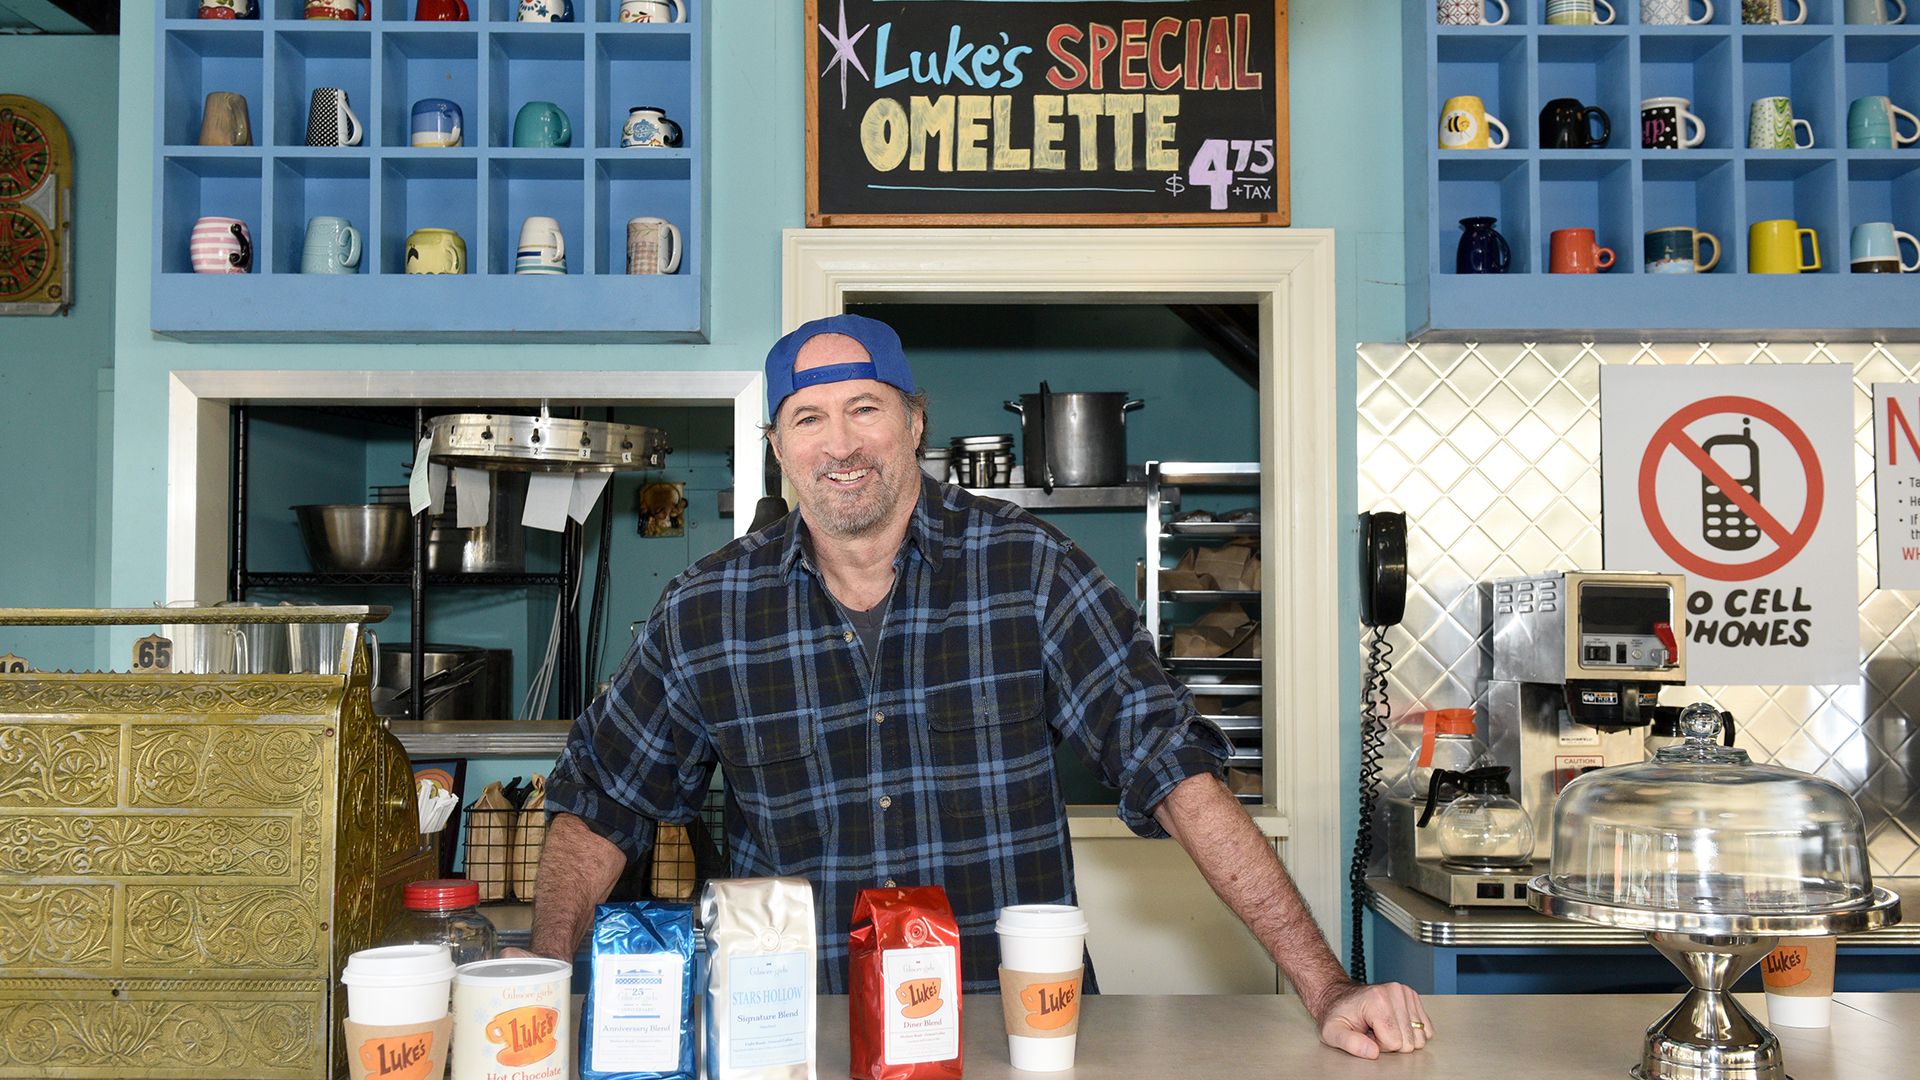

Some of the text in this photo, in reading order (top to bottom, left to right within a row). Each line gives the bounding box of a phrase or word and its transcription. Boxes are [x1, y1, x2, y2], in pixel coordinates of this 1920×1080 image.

[874, 13, 1262, 90] Luke's SPECIAL
[860, 94, 1180, 172] OMELETTE
[1724, 587, 1812, 617] CELL
[732, 986, 802, 1006] STARS HOLLOW
[908, 981, 937, 1006] Luke's
[1038, 985, 1075, 1015] Luke's
[737, 1009, 799, 1024] Signature Blend
[377, 1039, 426, 1076] Luke's
